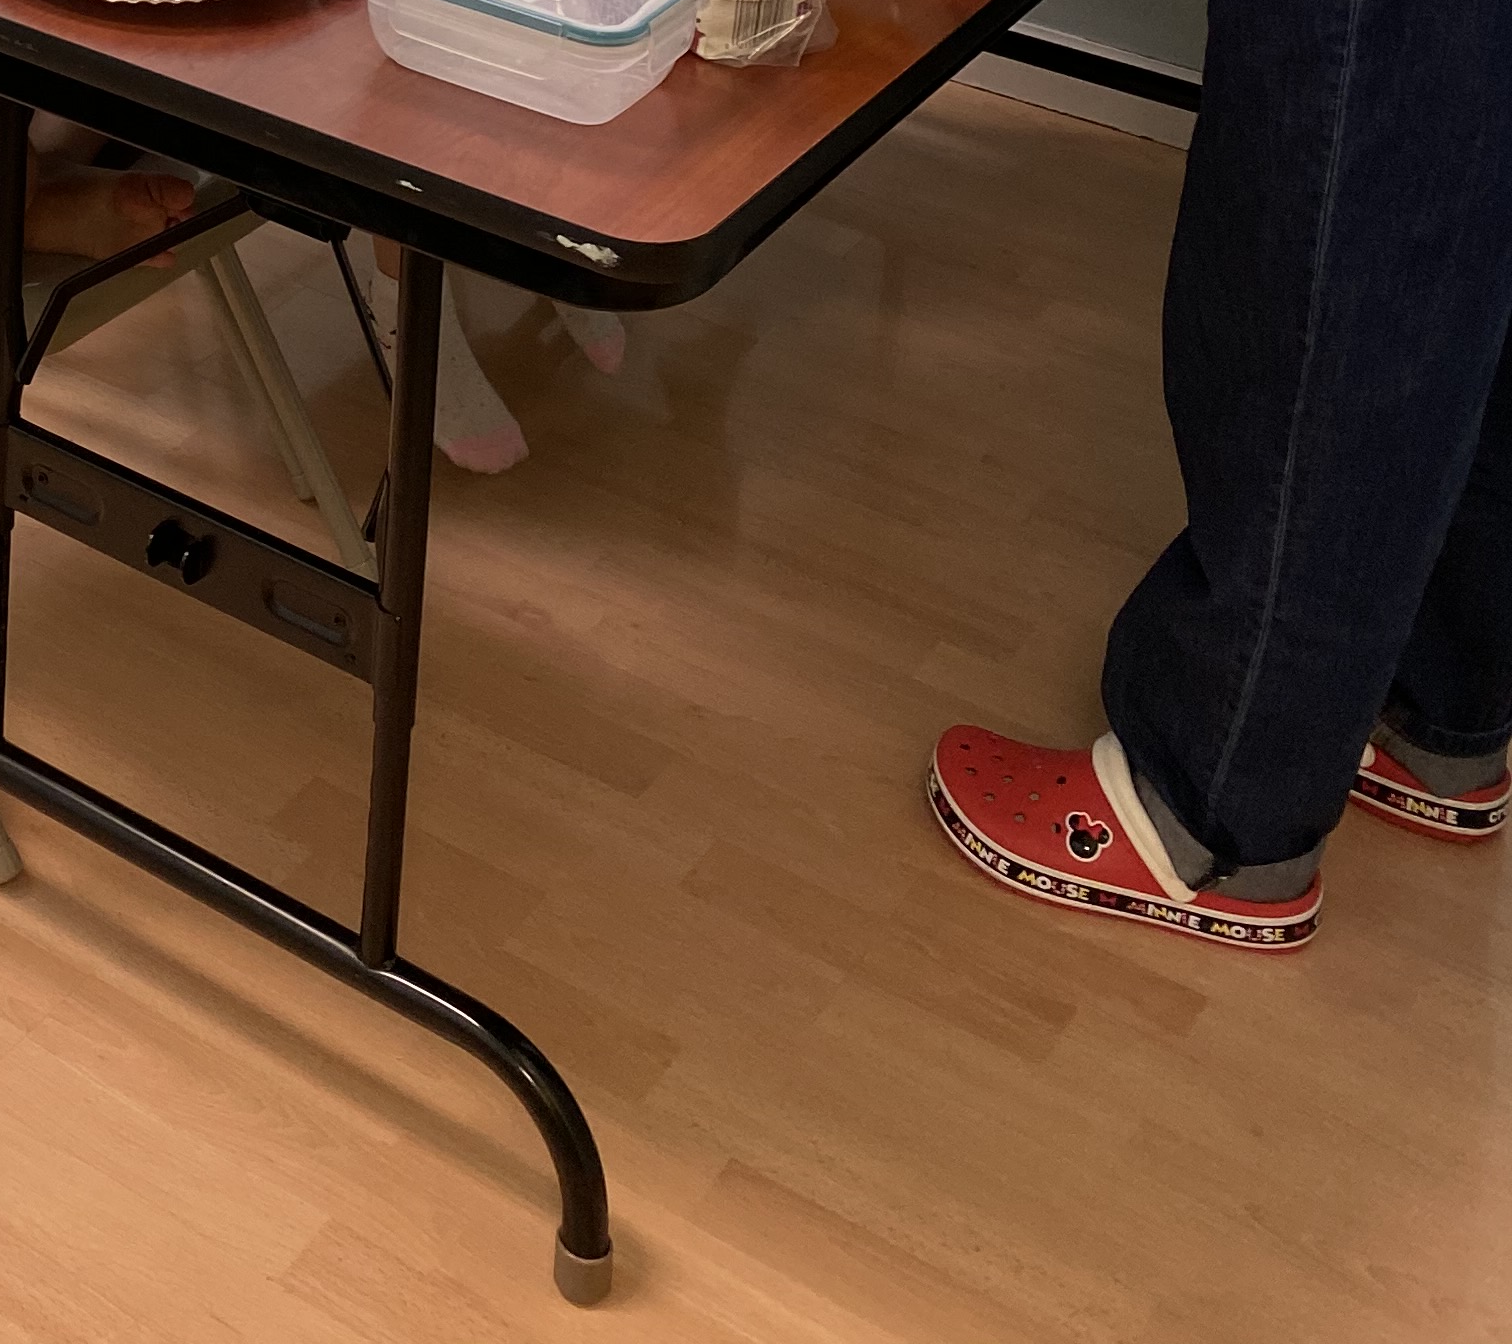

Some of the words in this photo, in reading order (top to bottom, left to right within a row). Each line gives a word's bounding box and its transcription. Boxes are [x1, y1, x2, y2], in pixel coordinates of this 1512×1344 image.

[1387, 793, 1459, 825] MINNIE
[952, 821, 1011, 875] MINNIE
[1017, 869, 1090, 901] MOUSE
[1126, 901, 1202, 930] MINNIE
[1210, 923, 1286, 943] MOUSE
